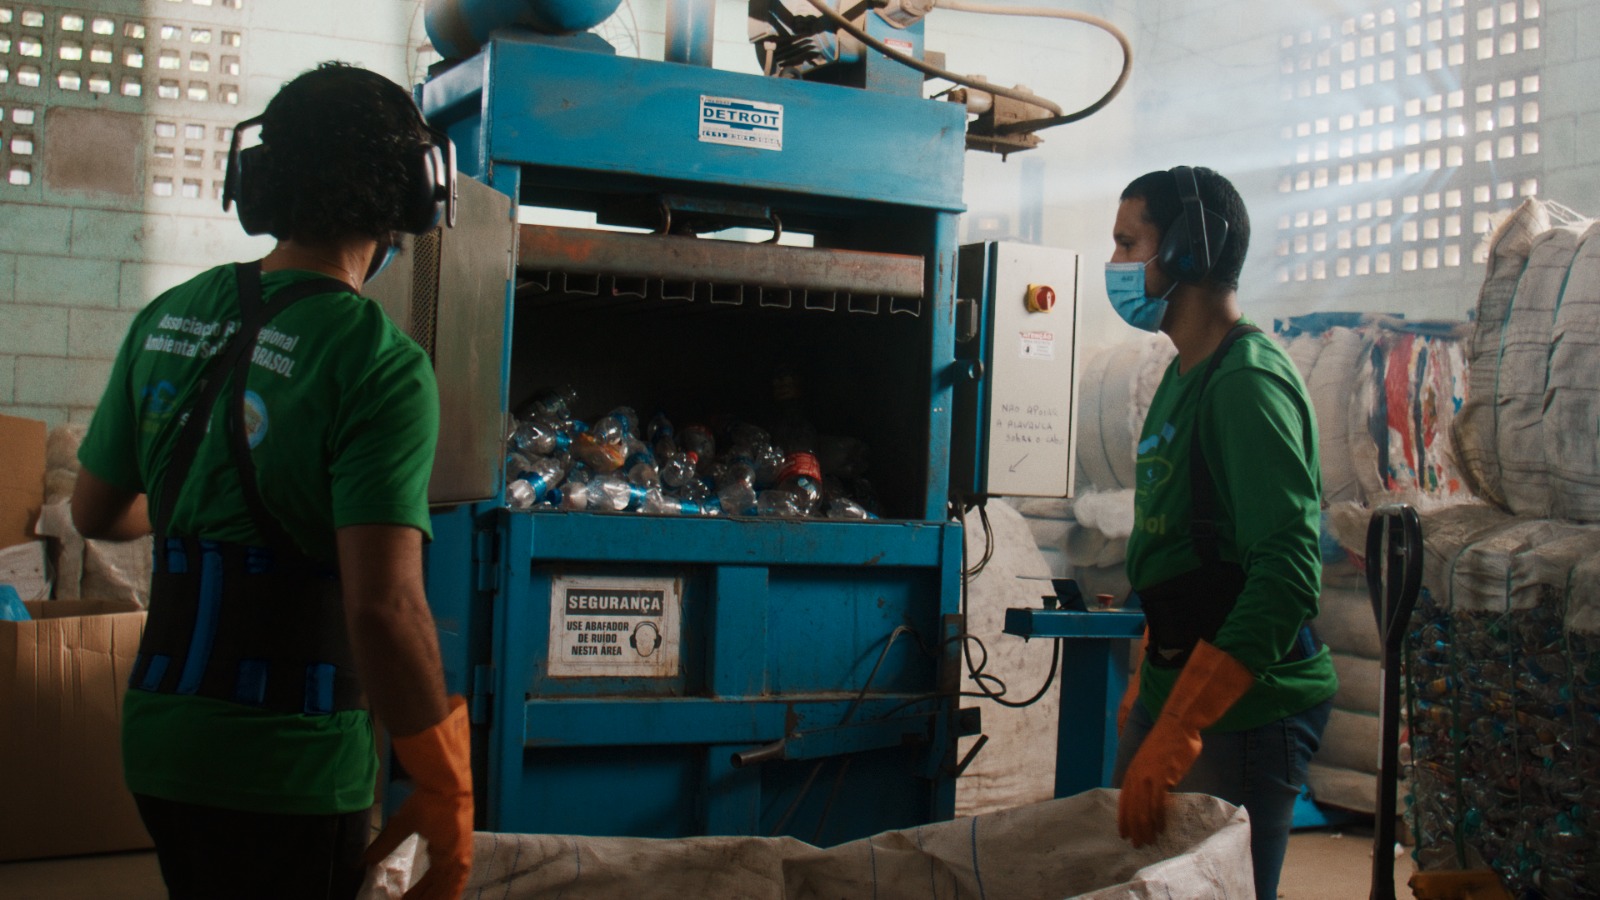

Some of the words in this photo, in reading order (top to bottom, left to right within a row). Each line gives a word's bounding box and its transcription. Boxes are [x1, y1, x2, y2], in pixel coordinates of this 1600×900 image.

[703, 107, 779, 126] DETROIT
[144, 333, 200, 357] Ambiental
[568, 595, 661, 614] SEGURANÇA
[567, 621, 582, 631] USE
[585, 621, 629, 631] ABAFADOR
[578, 633, 588, 643] DE
[571, 645, 598, 655] NESTA
